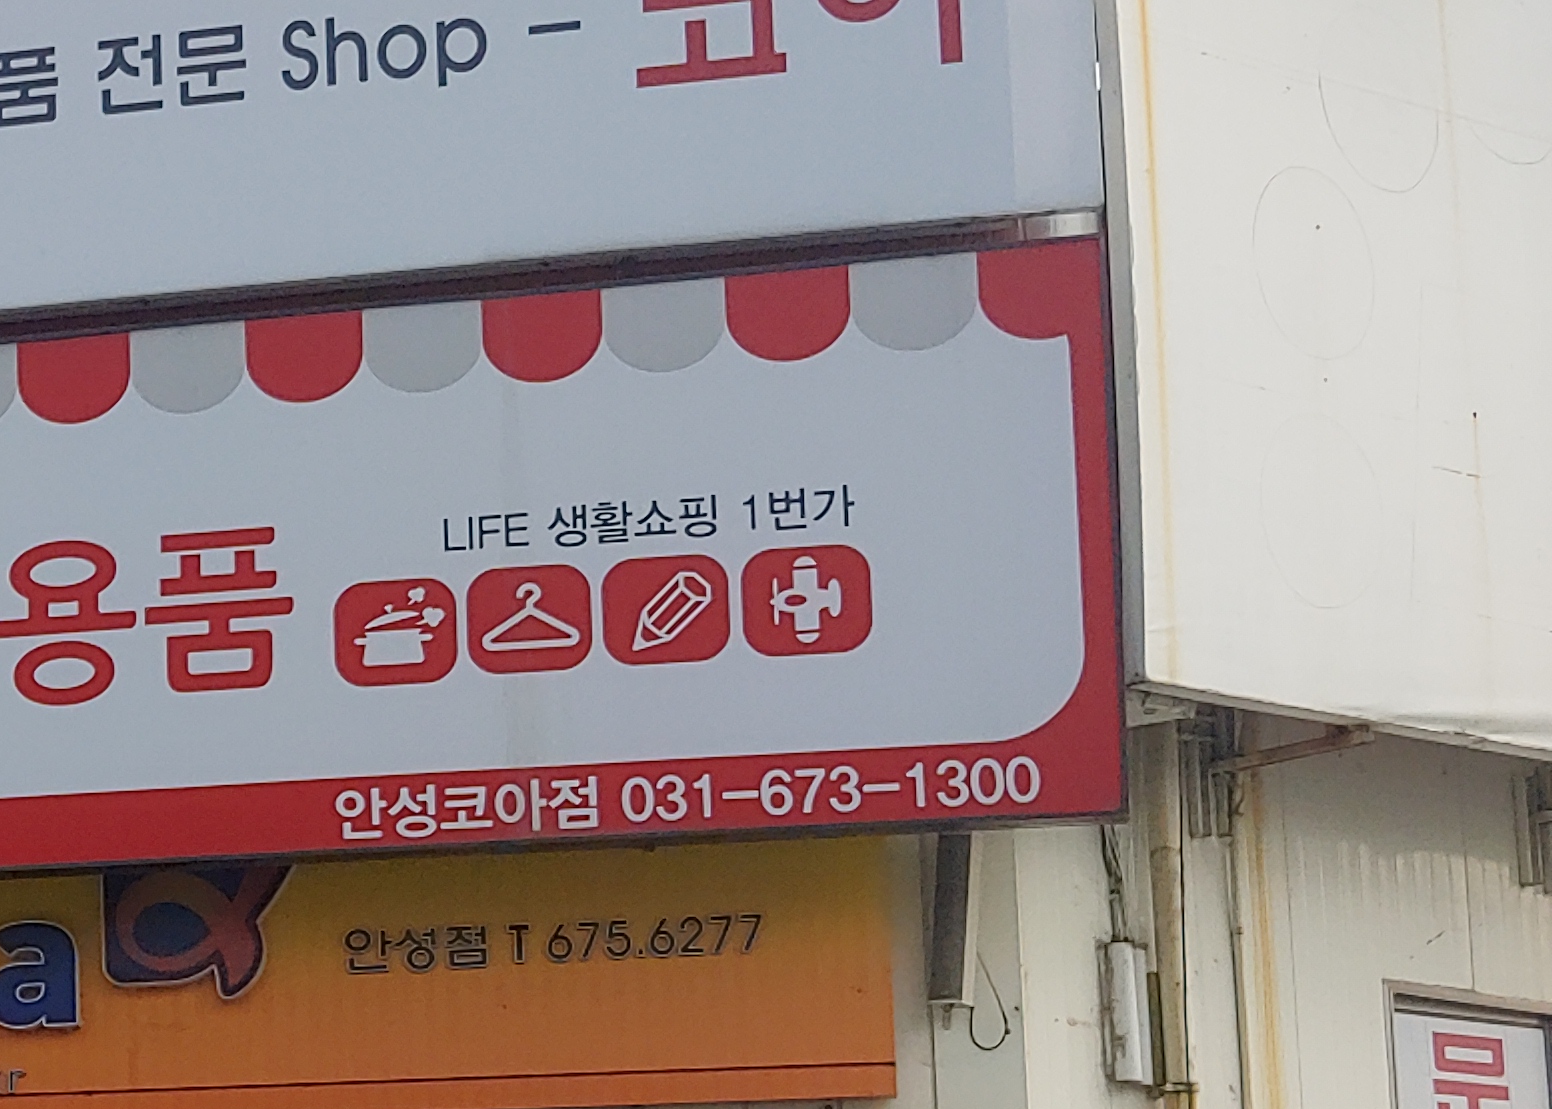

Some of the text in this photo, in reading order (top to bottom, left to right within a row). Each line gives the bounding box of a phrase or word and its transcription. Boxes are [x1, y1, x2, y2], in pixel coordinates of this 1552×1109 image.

[96, 23, 247, 116] 전문
[281, 12, 489, 93] Shop
[443, 483, 856, 554] LIFE 생활쇼핑 1번가
[334, 755, 1041, 841] 안성코아점 031-673-1300
[344, 913, 763, 974] 안성점 T 675.6277
